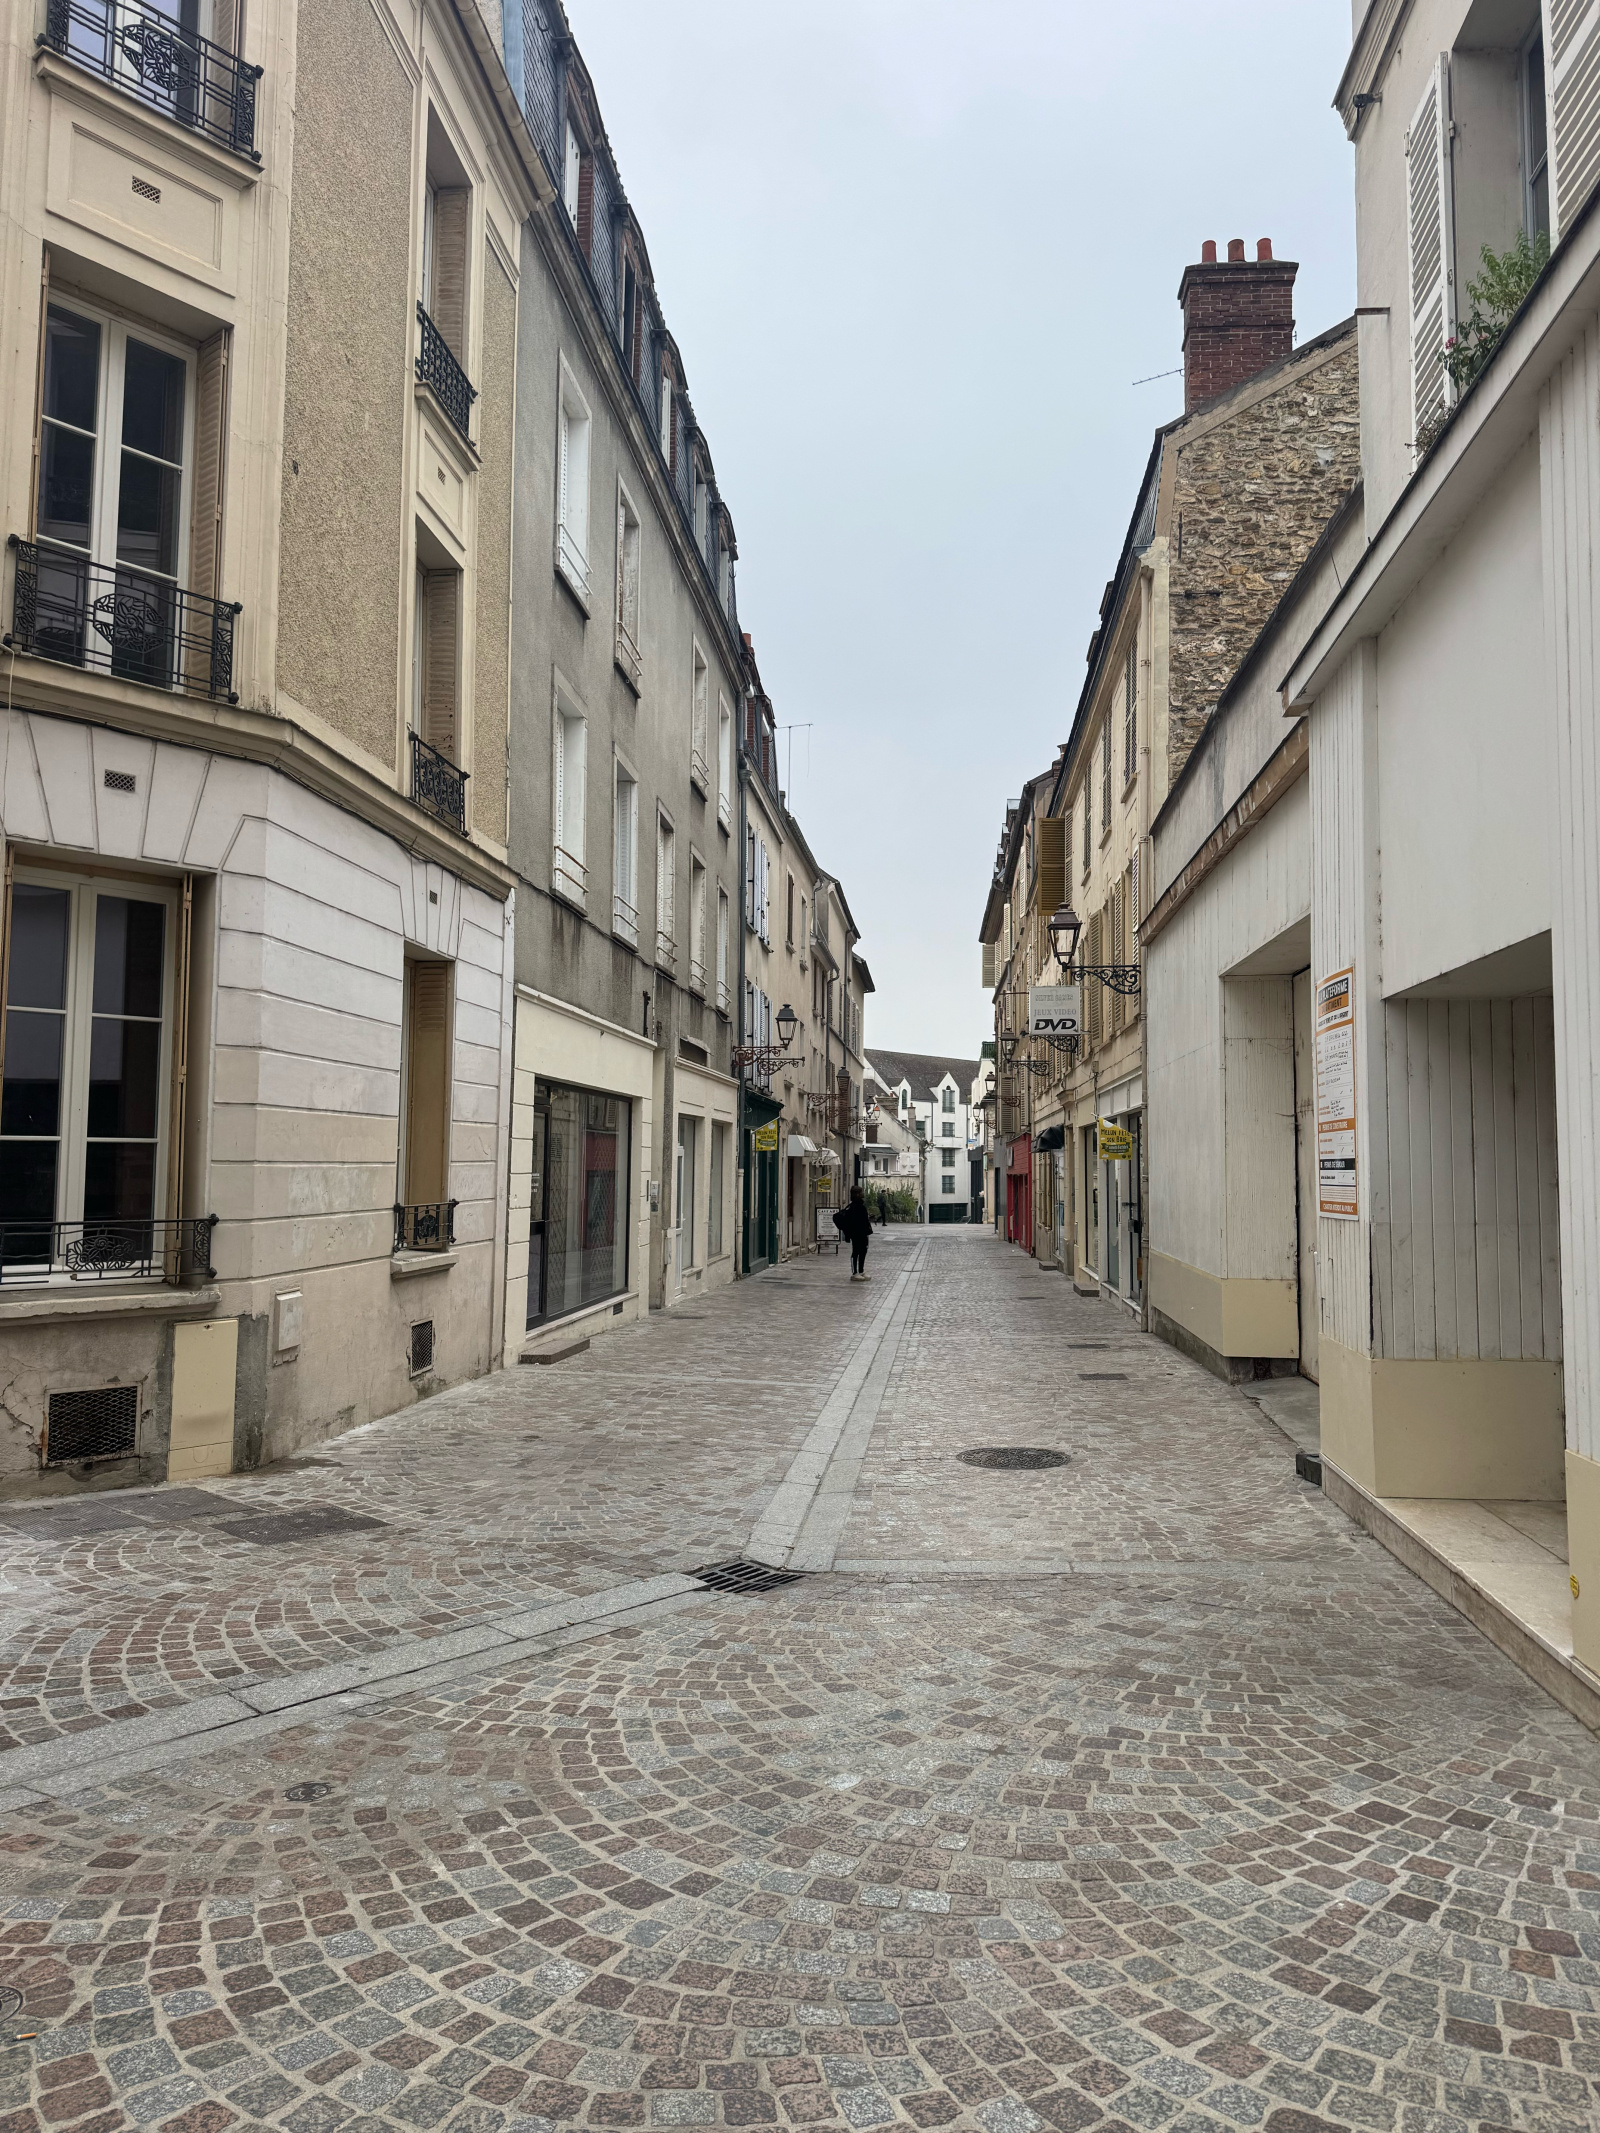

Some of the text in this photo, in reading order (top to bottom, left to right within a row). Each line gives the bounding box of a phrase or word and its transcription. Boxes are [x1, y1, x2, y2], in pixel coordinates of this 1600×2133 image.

[1322, 979, 1348, 1001] PLATEFORME
[1034, 1008, 1077, 1017] JEUX VIDEO
[1034, 1018, 1077, 1032] DVD
[1101, 1128, 1117, 1136] MELUN
[1116, 1135, 1127, 1143] BRIE
